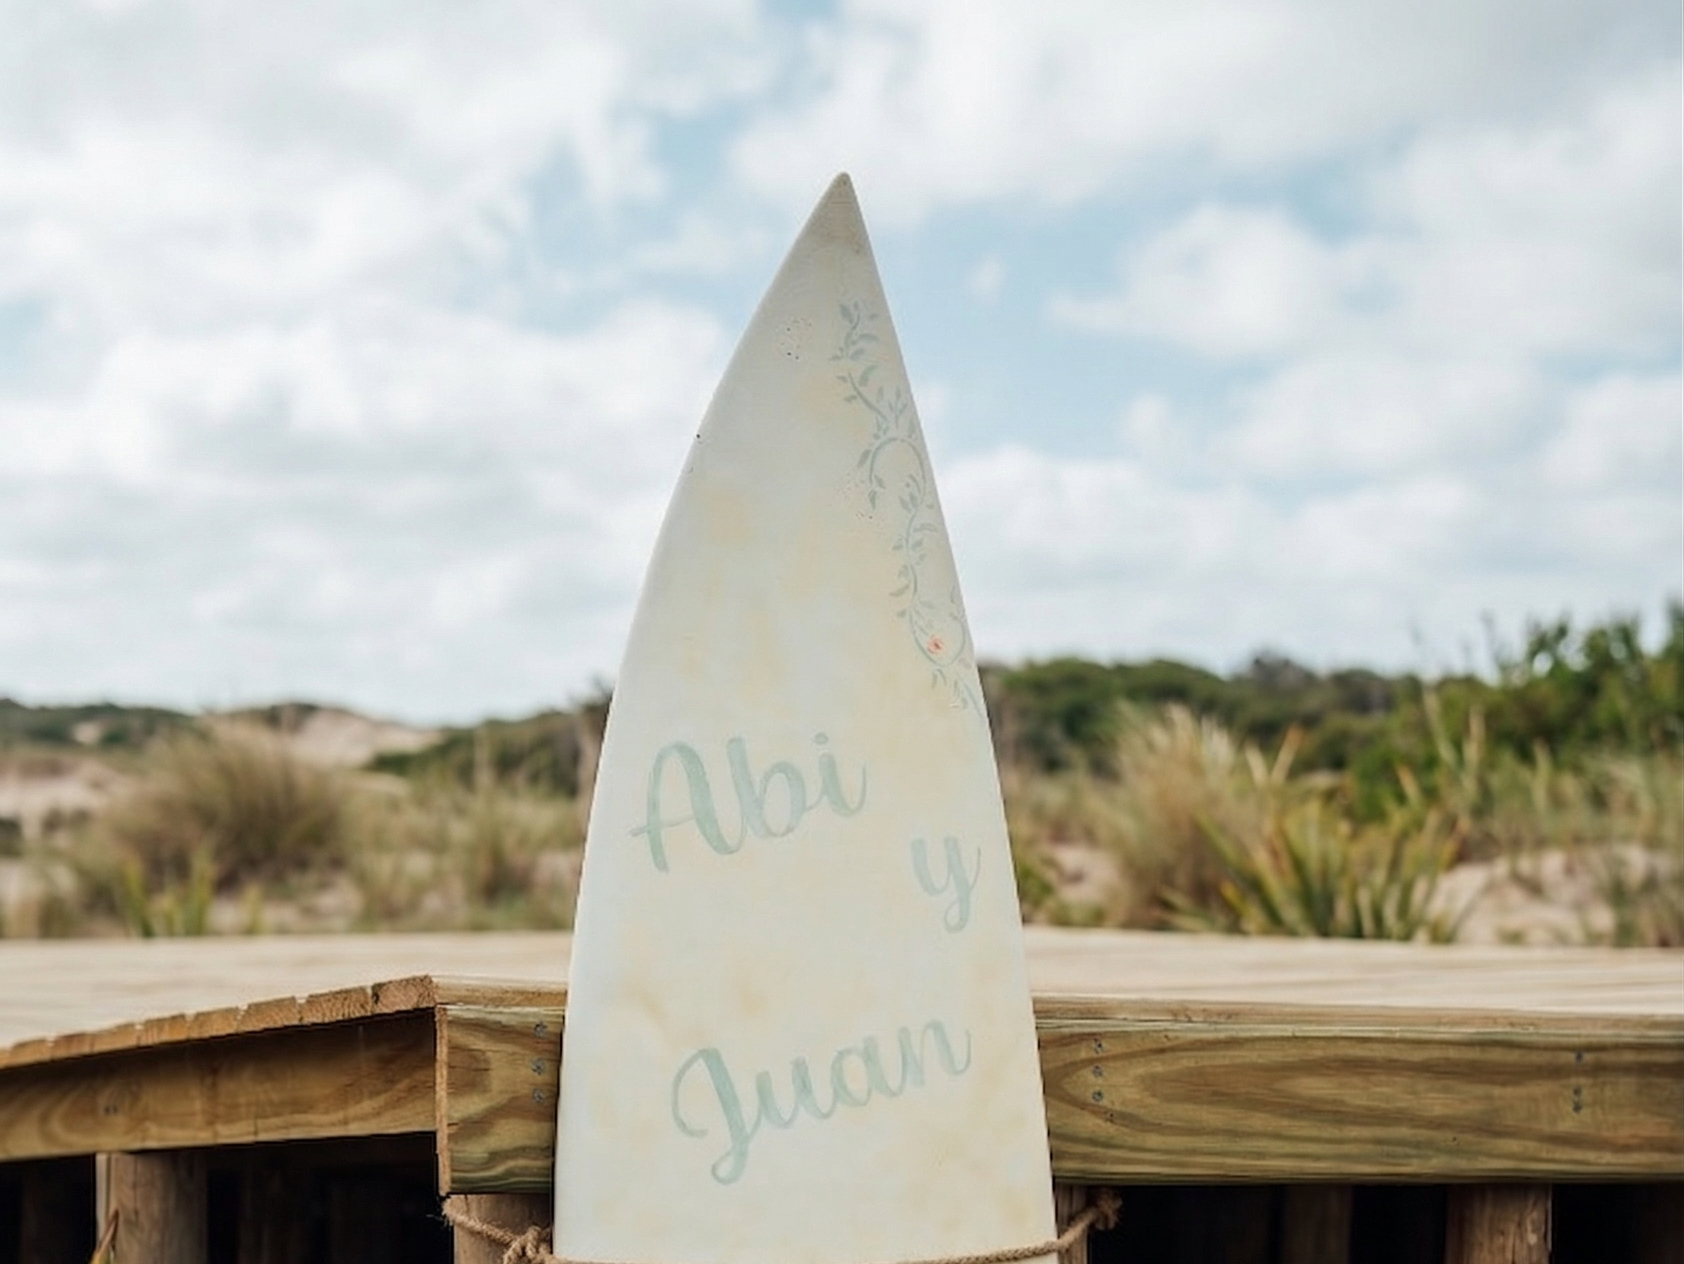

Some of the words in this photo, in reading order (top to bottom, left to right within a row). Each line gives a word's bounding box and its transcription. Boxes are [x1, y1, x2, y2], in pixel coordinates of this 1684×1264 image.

[628, 731, 867, 874] Abi
[911, 836, 982, 934] y
[671, 1019, 973, 1186] Juan
